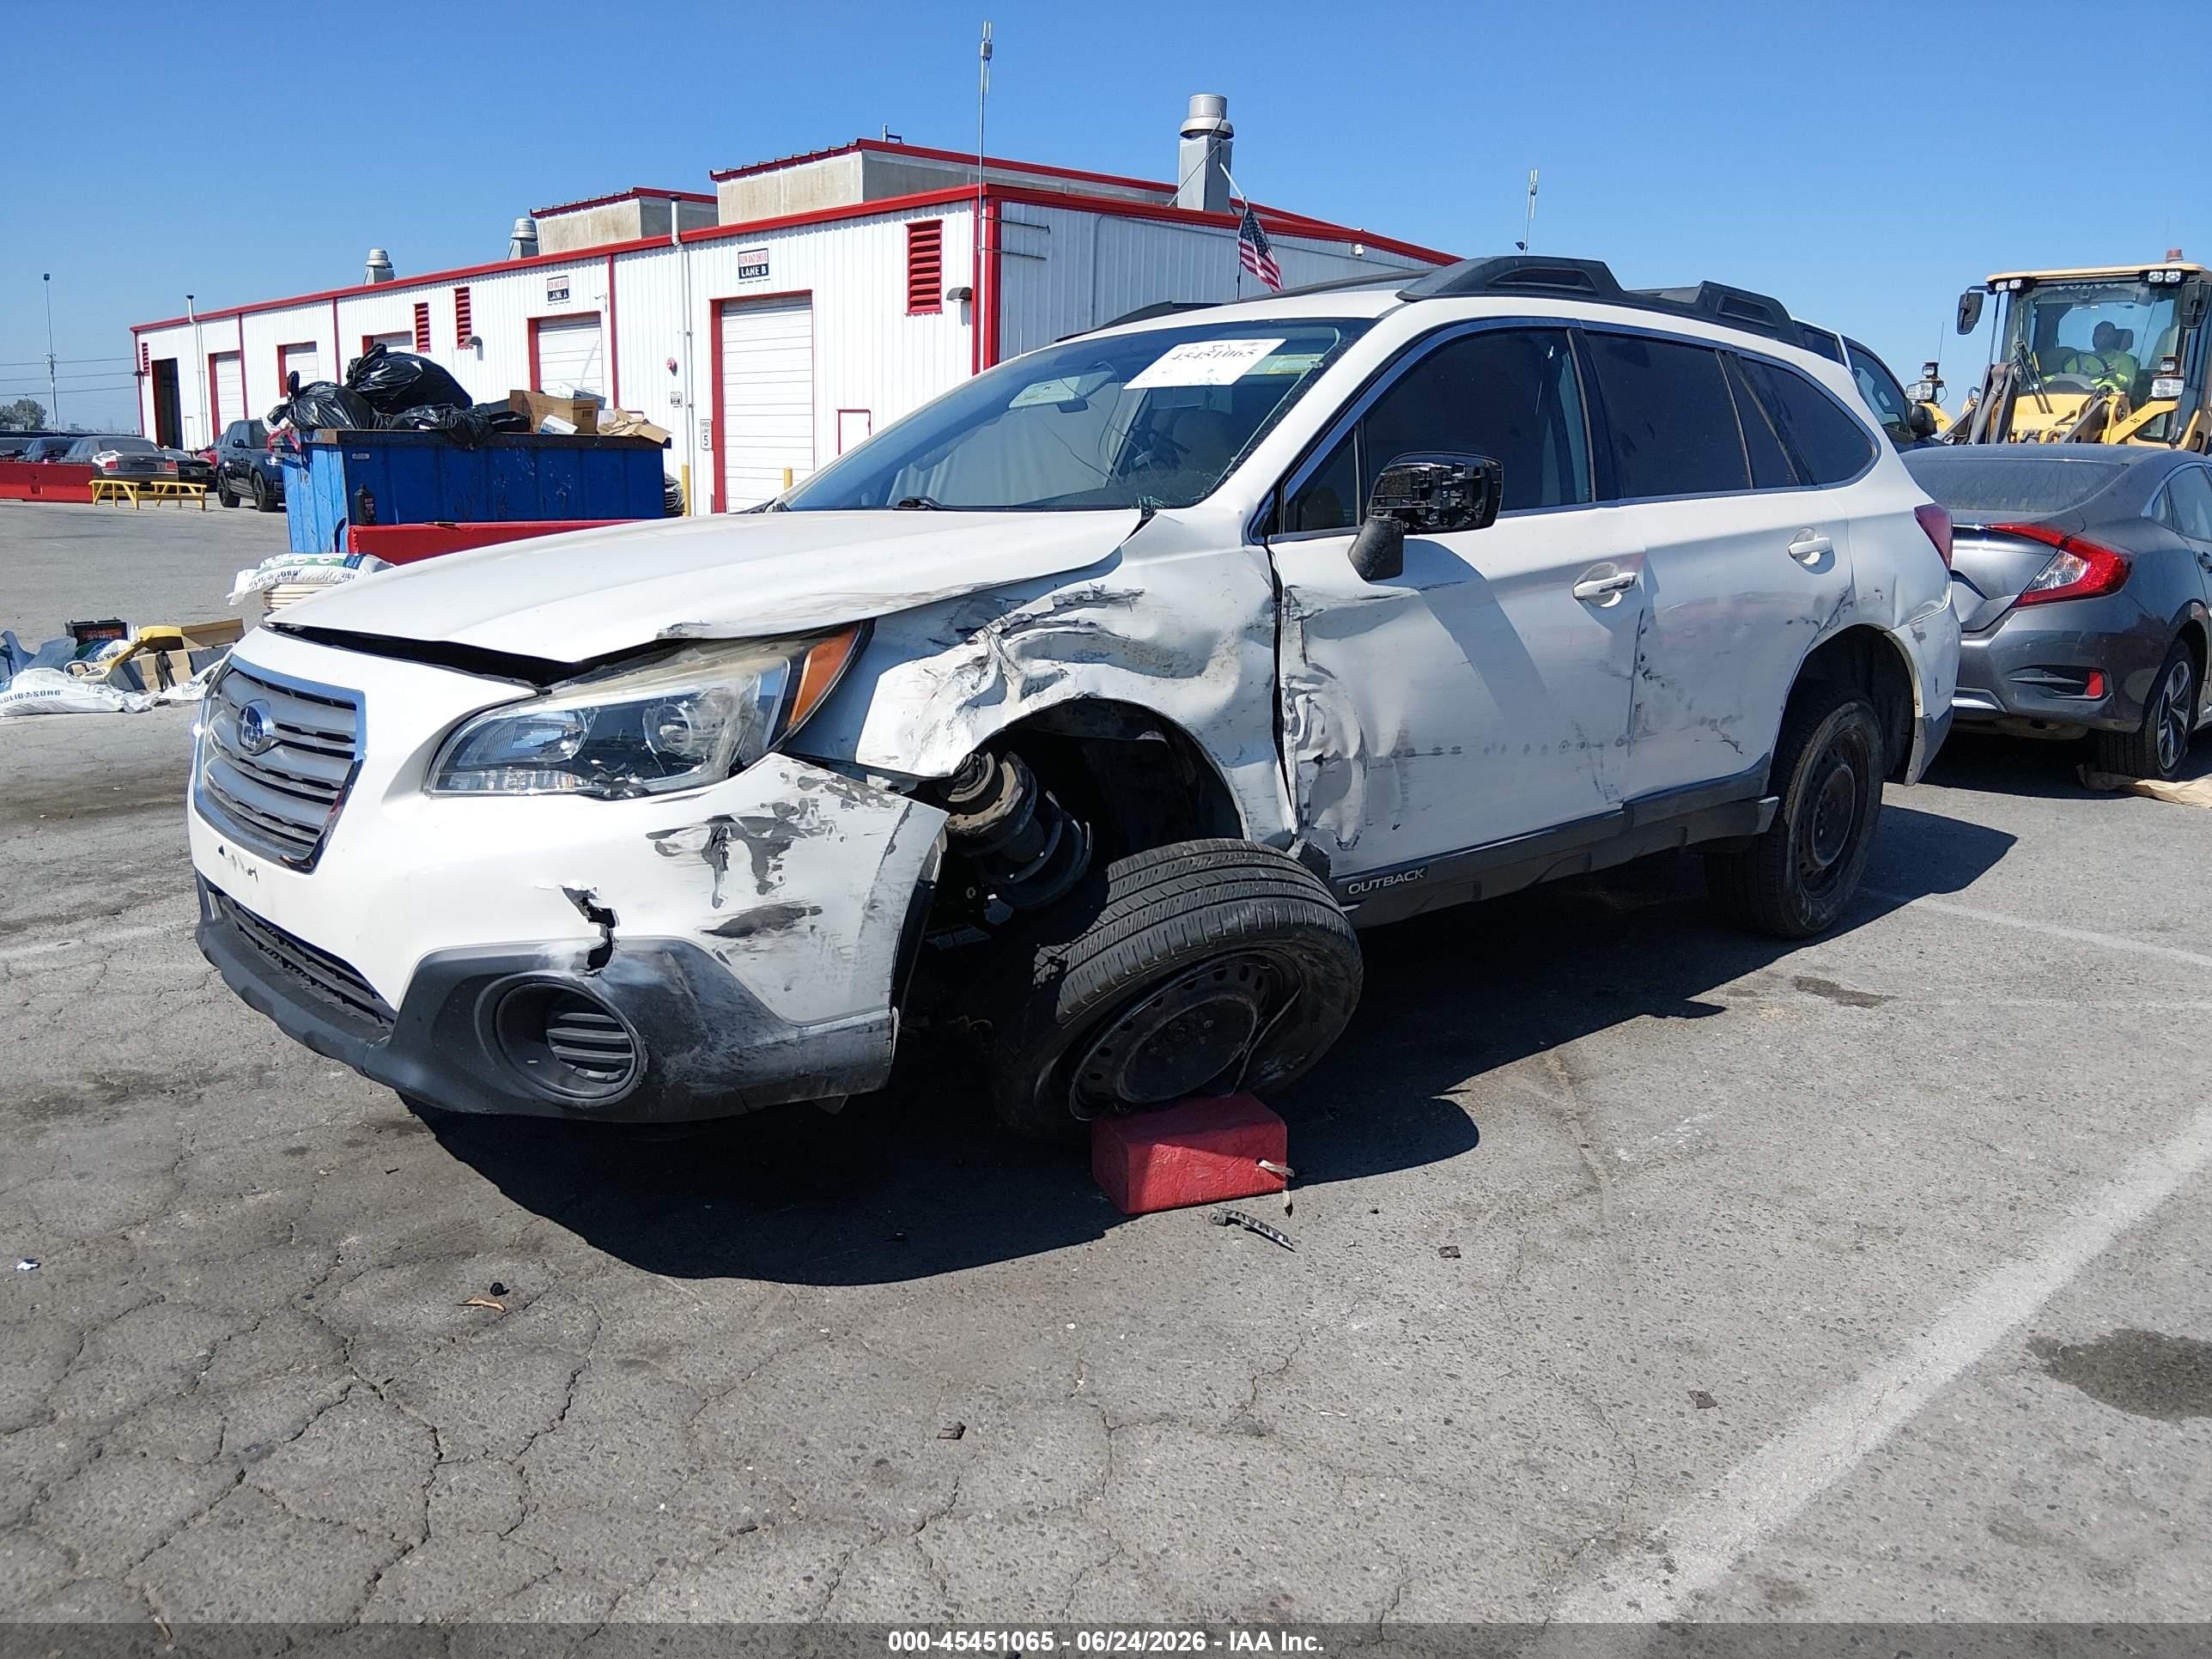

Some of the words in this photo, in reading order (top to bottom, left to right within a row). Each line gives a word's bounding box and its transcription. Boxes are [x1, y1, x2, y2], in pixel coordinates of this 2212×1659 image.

[741, 266, 760, 276] LANE
[761, 265, 767, 275] B
[549, 291, 562, 300] LANE
[563, 289, 568, 299] A
[703, 435, 708, 446] 5
[1348, 867, 1426, 895] OUTBACK
